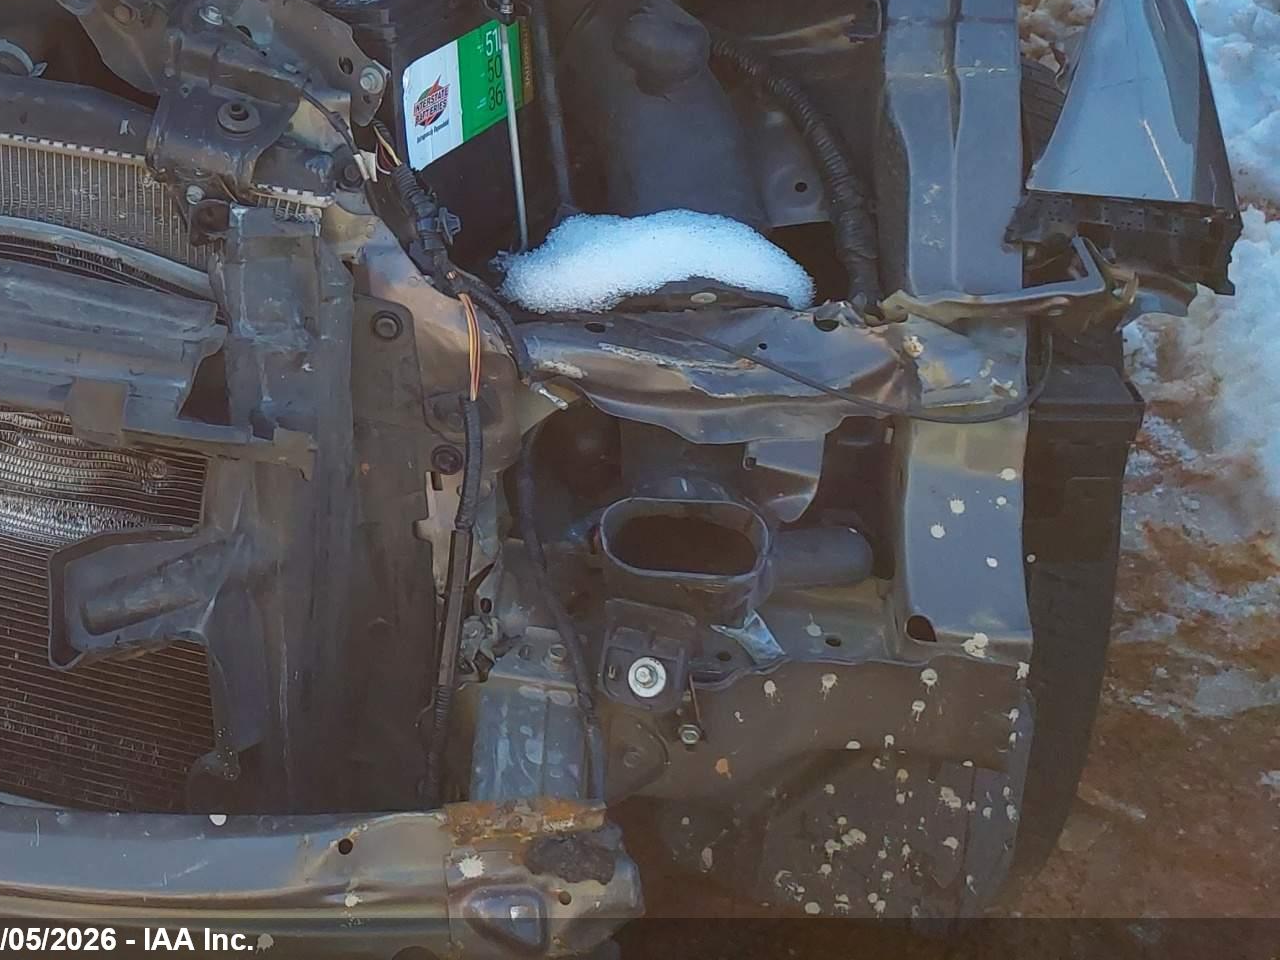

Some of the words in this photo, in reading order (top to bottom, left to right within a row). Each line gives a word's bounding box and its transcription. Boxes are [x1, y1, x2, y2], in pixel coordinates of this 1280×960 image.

[485, 28, 502, 56] 51
[413, 86, 449, 116] INTERSTATE
[488, 84, 505, 111] 36
[415, 100, 447, 125] BATTERIES
